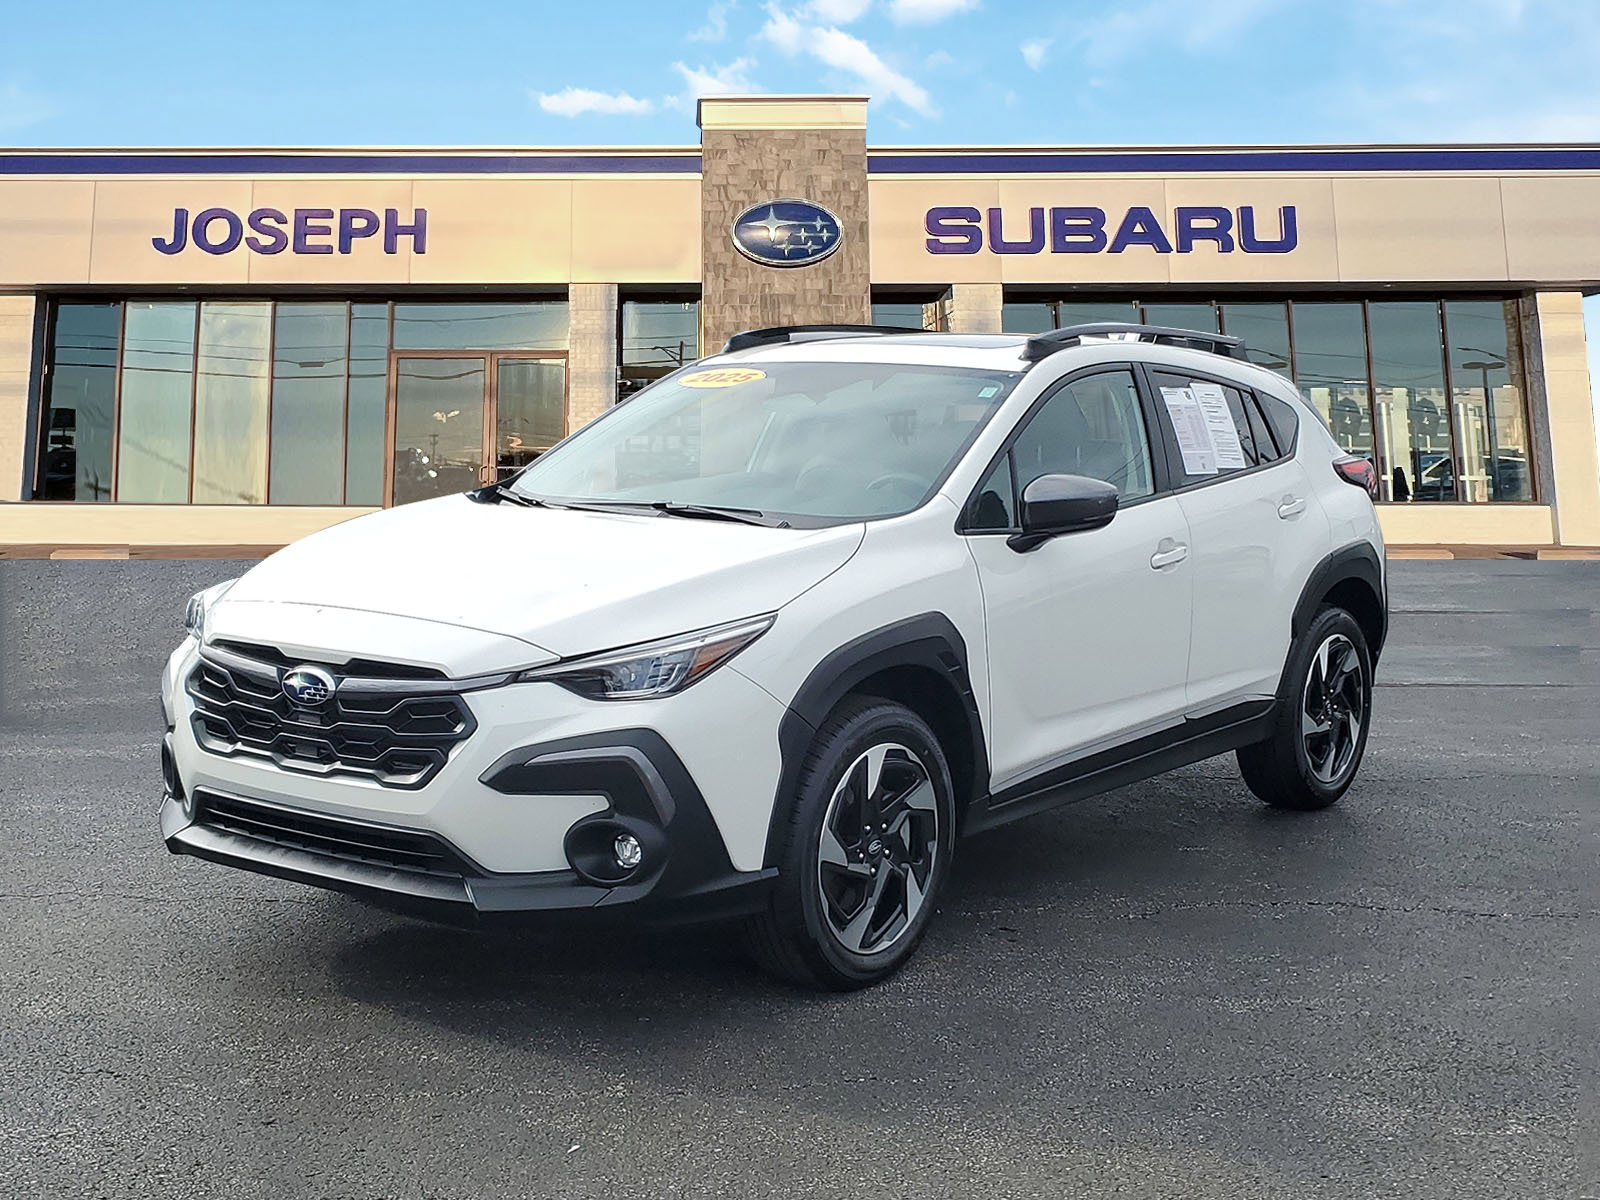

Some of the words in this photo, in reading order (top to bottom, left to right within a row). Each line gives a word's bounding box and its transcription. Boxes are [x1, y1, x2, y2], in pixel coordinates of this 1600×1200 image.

[152, 208, 428, 255] JOSEPH
[925, 206, 1298, 254] SUBARU
[686, 372, 759, 383] 2025
